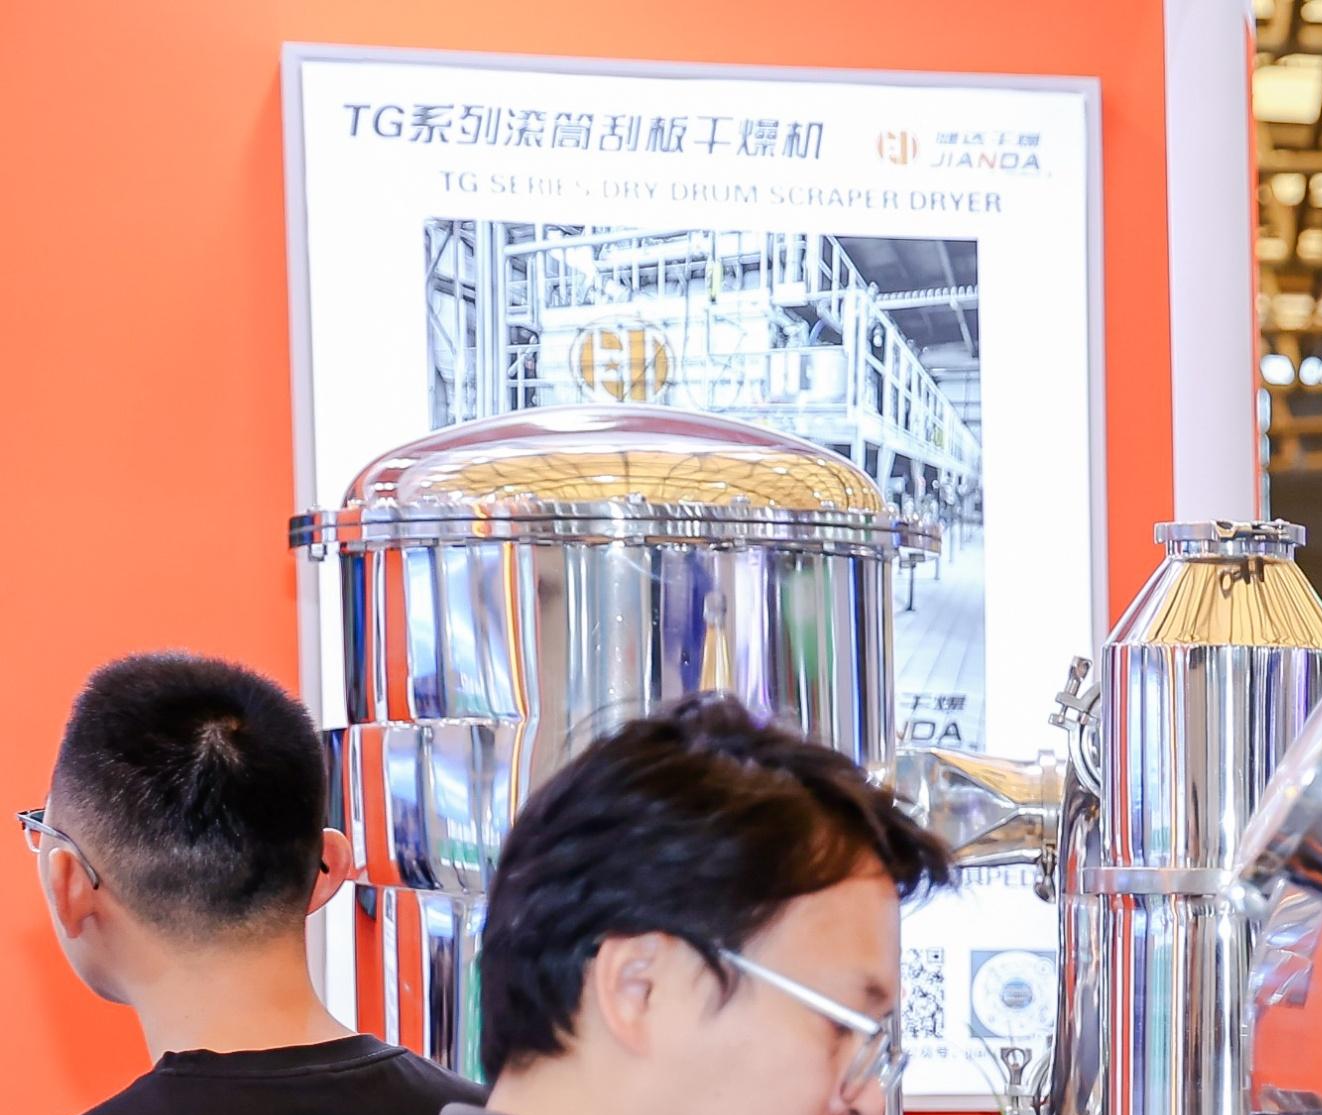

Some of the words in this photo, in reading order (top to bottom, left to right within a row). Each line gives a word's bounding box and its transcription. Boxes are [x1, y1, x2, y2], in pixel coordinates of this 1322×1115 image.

[341, 101, 826, 162] TG系列滚筒刮板干燥机
[930, 151, 1041, 171] JIANDA
[439, 170, 479, 193] TG
[602, 178, 658, 200] DRY
[670, 180, 758, 204] DRUM
[769, 184, 899, 210] SCRAPER
[909, 190, 1002, 213] DRYER
